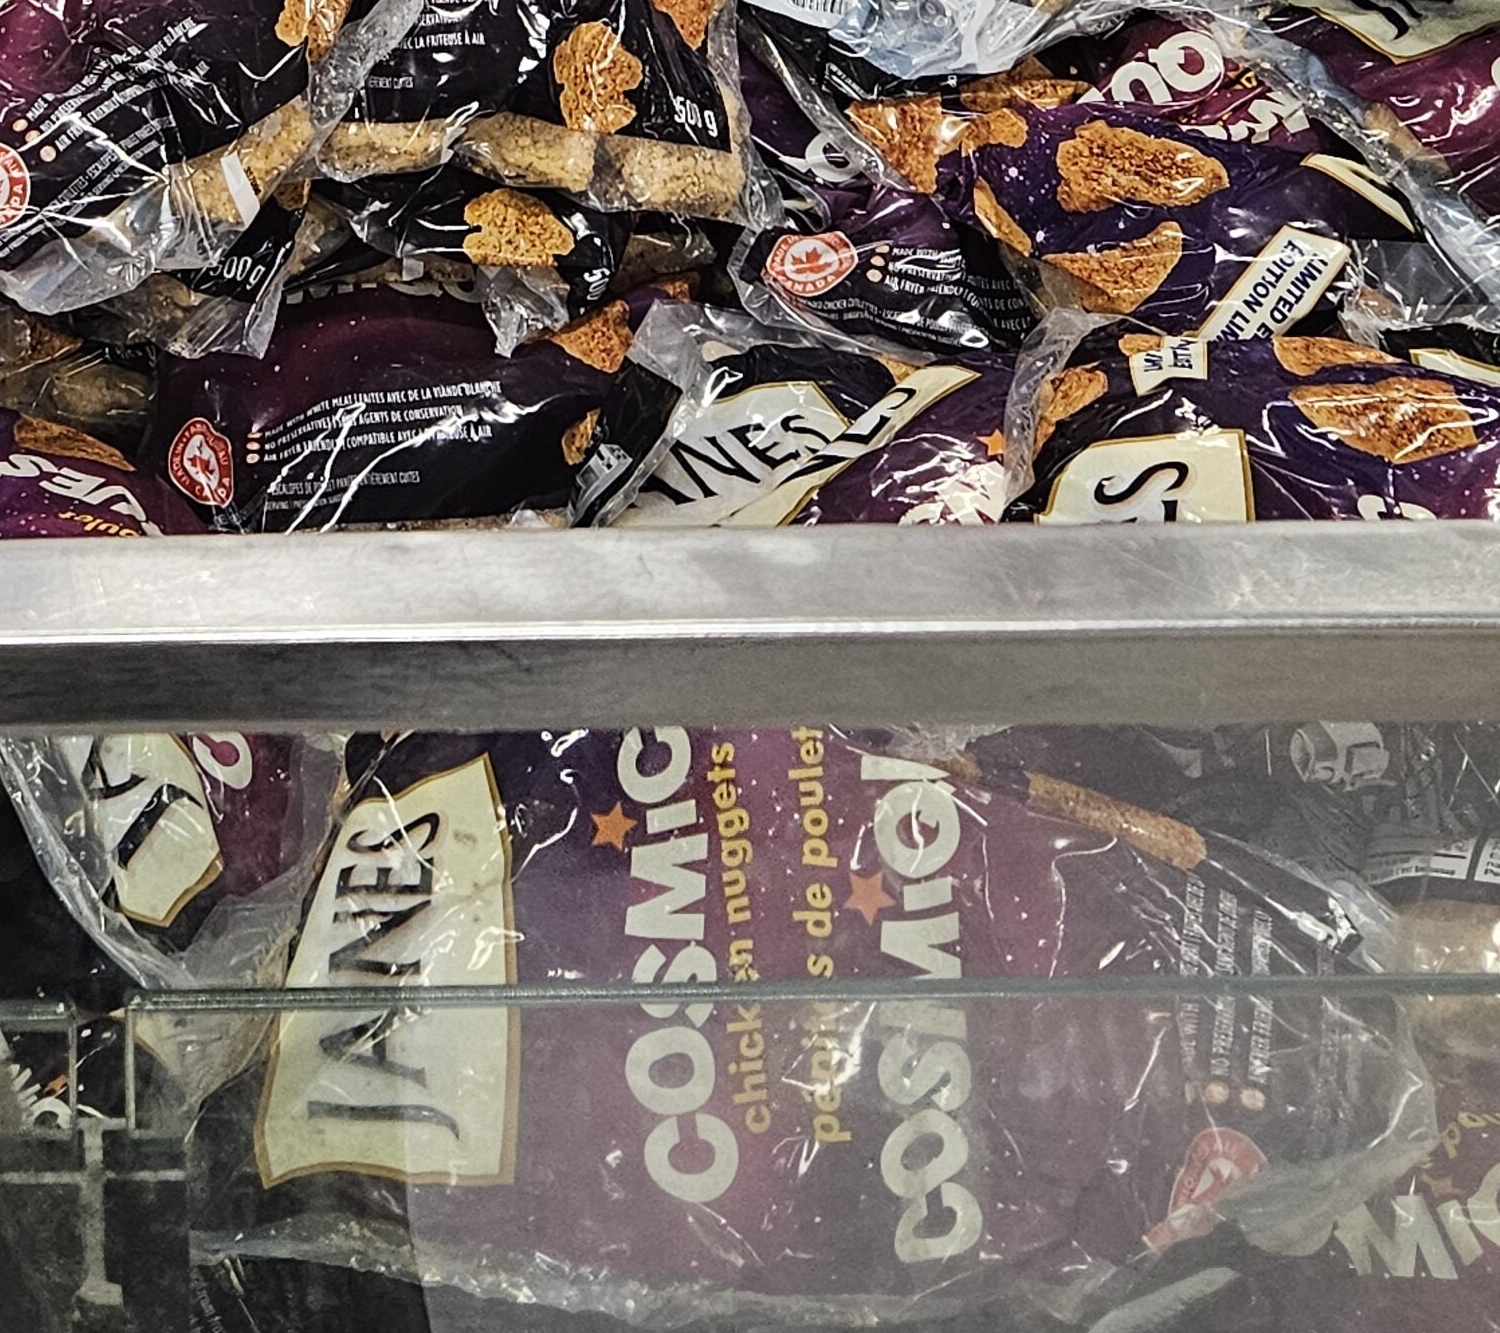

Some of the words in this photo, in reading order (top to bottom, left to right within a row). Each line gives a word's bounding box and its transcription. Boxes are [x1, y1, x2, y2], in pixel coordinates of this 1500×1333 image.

[426, 32, 462, 46] FRITEUSE
[471, 32, 486, 45] AIR
[703, 109, 718, 139] g
[1269, 256, 1329, 324] LIMITED
[391, 410, 402, 423] DE
[407, 389, 419, 402] DE
[420, 387, 432, 400] LA
[791, 727, 837, 869] poulet
[706, 740, 751, 927] nuggets
[794, 882, 833, 939] de
[306, 809, 459, 1141] JANES
[618, 727, 738, 1201] COSMIC
